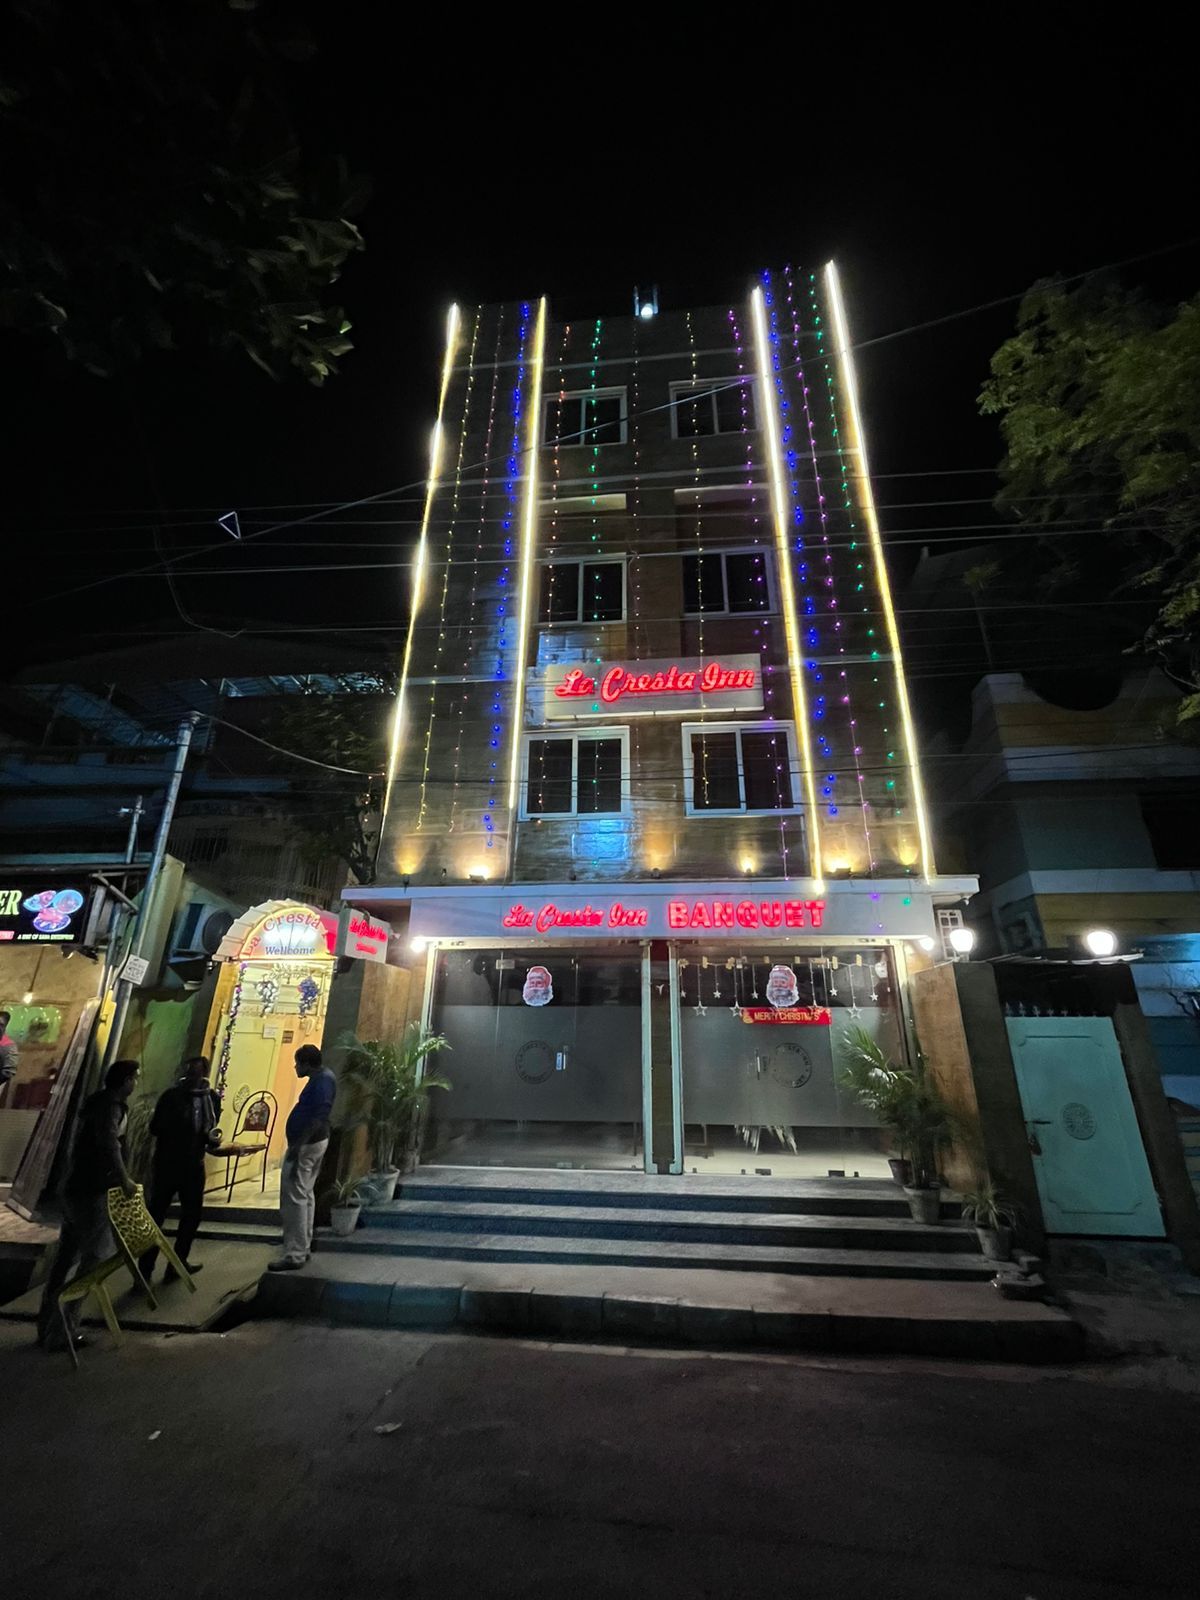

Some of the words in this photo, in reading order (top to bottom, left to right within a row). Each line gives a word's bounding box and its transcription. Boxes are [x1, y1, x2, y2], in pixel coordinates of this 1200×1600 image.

[554, 668, 594, 697] La
[600, 665, 696, 703] Cresta
[701, 662, 755, 692] Inn
[503, 904, 534, 928] La
[536, 903, 604, 934] Cresta
[608, 902, 648, 929] Inn
[668, 899, 827, 929] BANQUET
[242, 937, 261, 956] La
[263, 912, 321, 932] Cresta
